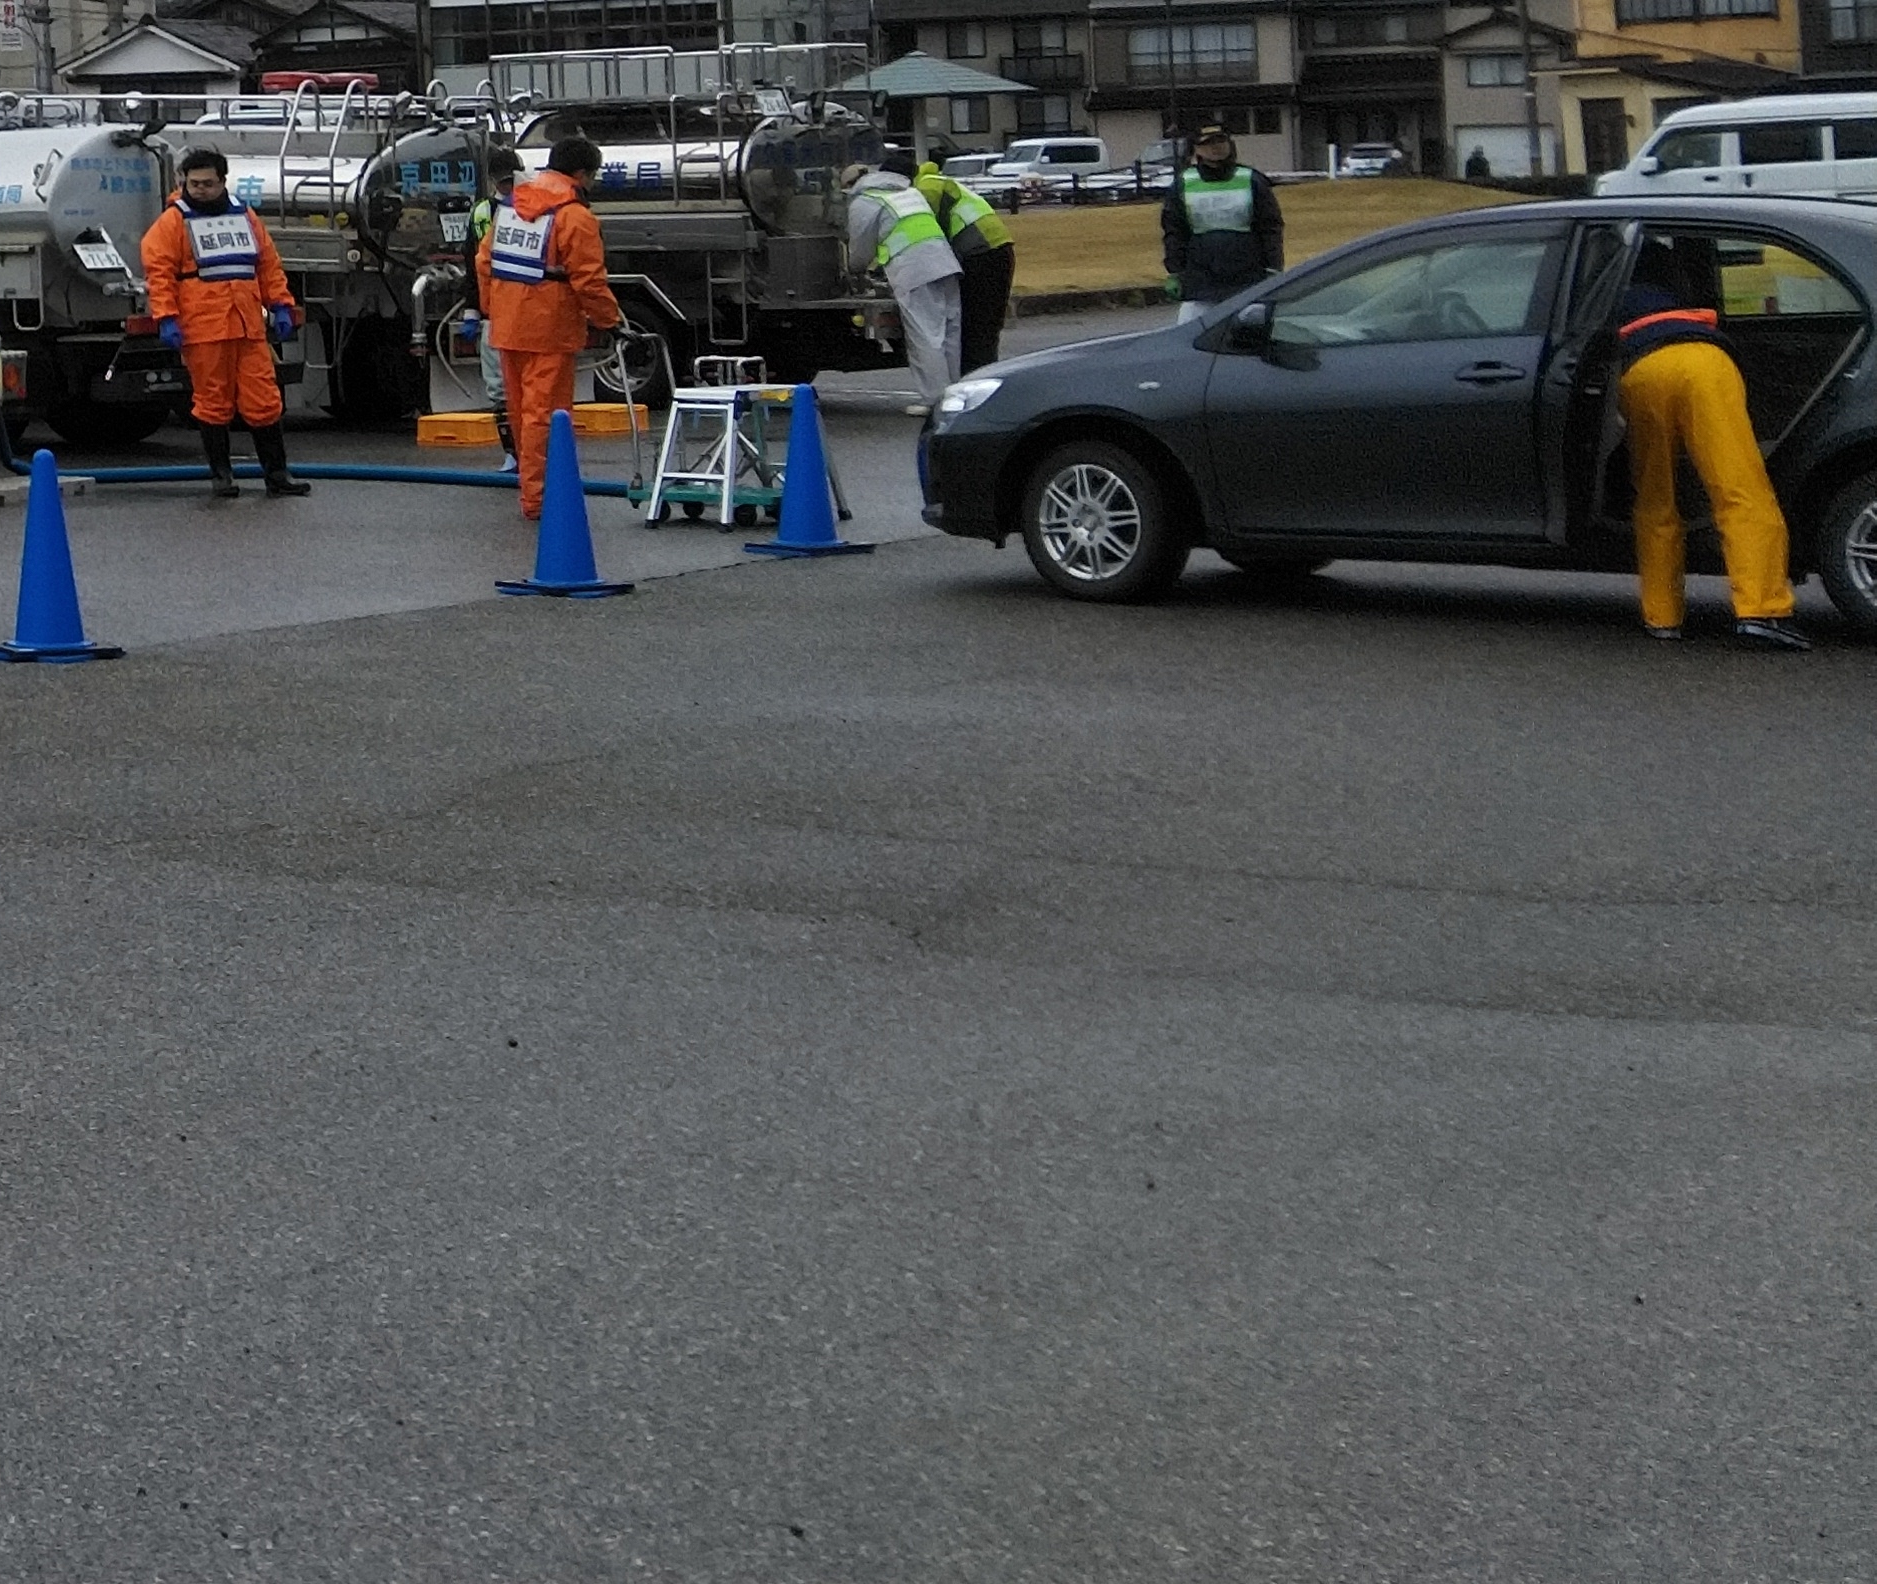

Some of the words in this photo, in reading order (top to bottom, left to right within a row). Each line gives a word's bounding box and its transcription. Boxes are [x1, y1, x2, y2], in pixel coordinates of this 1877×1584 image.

[199, 231, 251, 251] 延岡市
[496, 224, 542, 251] 延岡市
